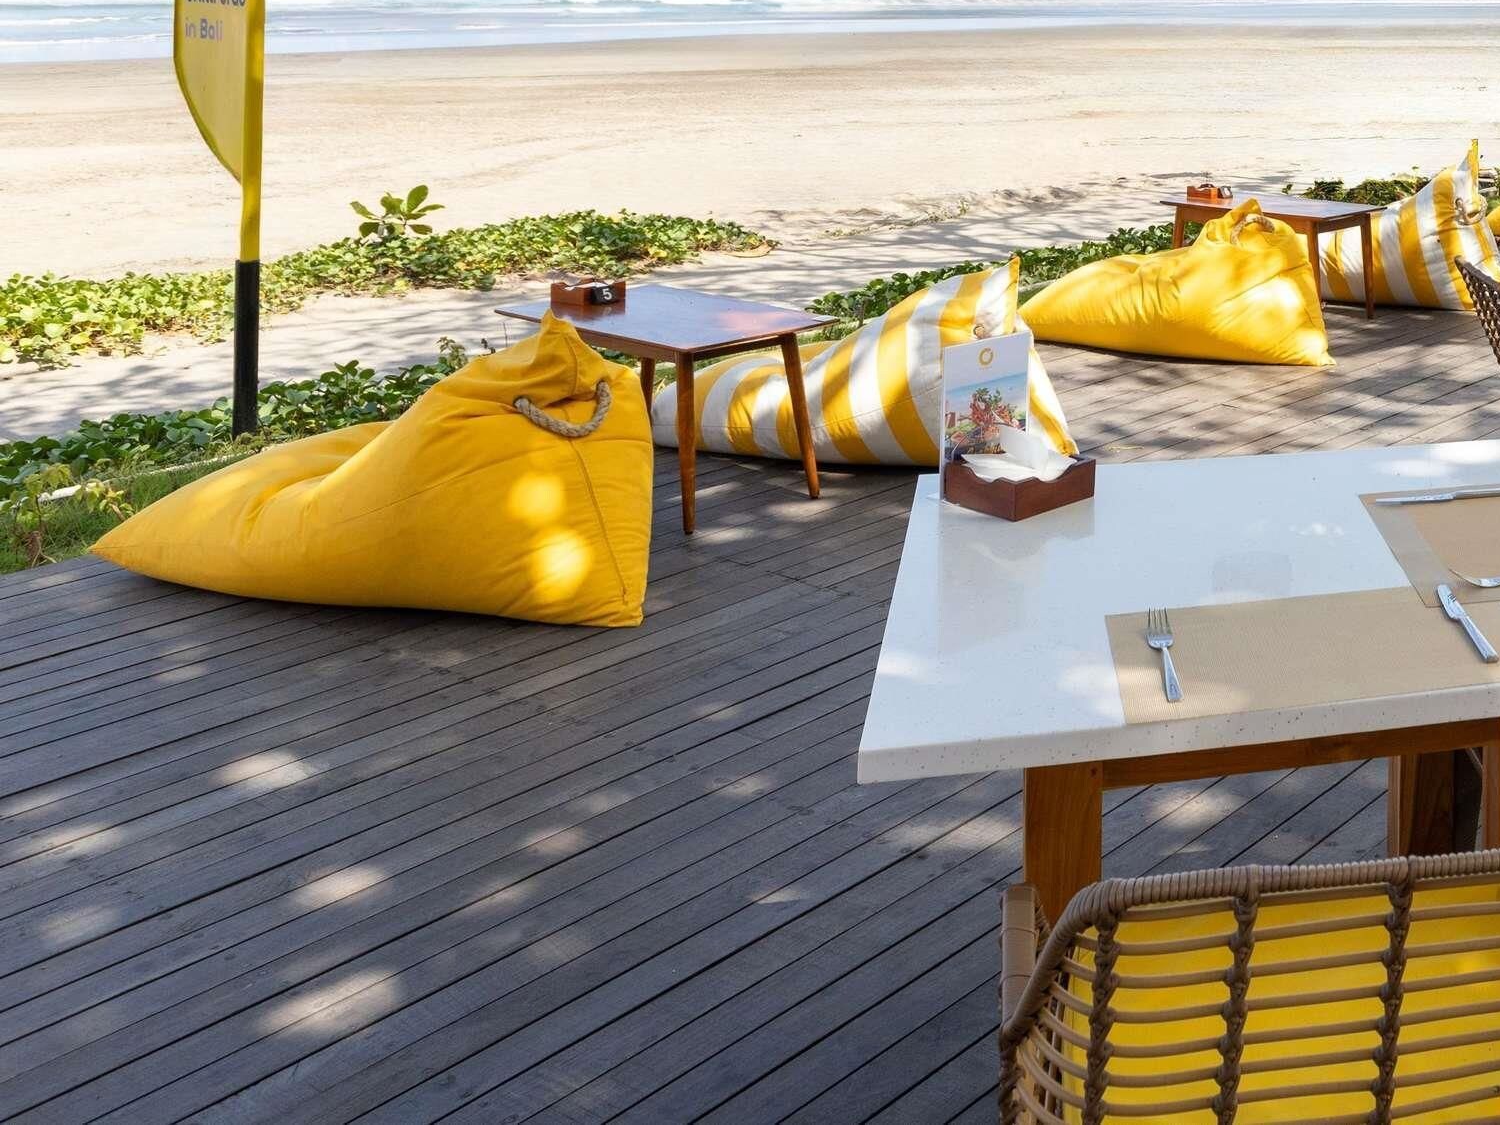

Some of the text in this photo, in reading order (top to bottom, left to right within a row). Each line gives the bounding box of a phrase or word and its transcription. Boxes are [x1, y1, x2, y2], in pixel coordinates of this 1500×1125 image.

[185, 17, 224, 42] in Bali
[602, 288, 613, 301] 5
